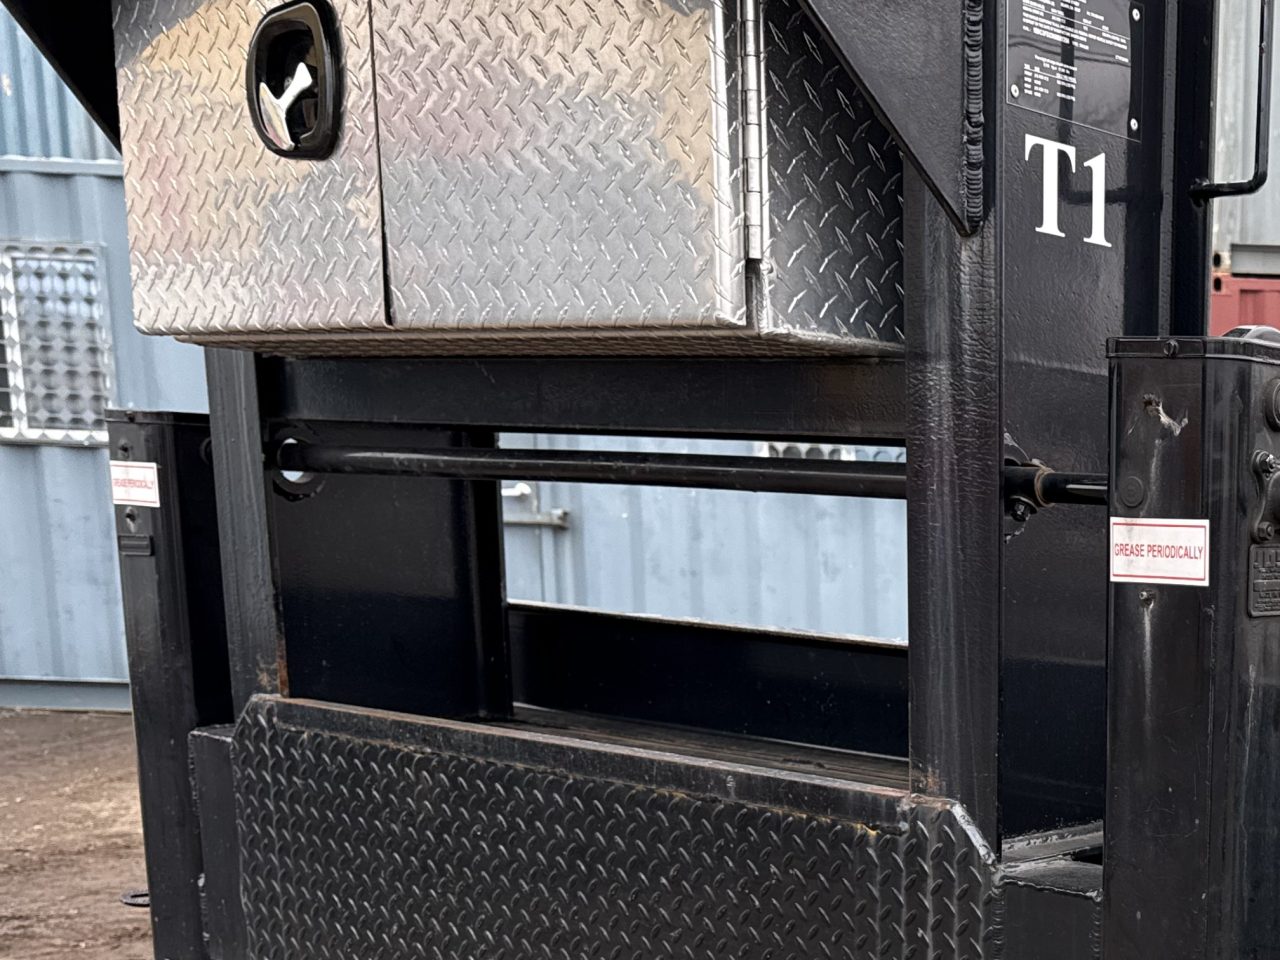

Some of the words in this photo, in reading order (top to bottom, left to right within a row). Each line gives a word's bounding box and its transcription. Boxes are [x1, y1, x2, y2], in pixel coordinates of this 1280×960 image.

[1025, 133, 1112, 247] T1
[1114, 543, 1145, 557] GREASE
[1147, 544, 1204, 560] PERIODICALLY
